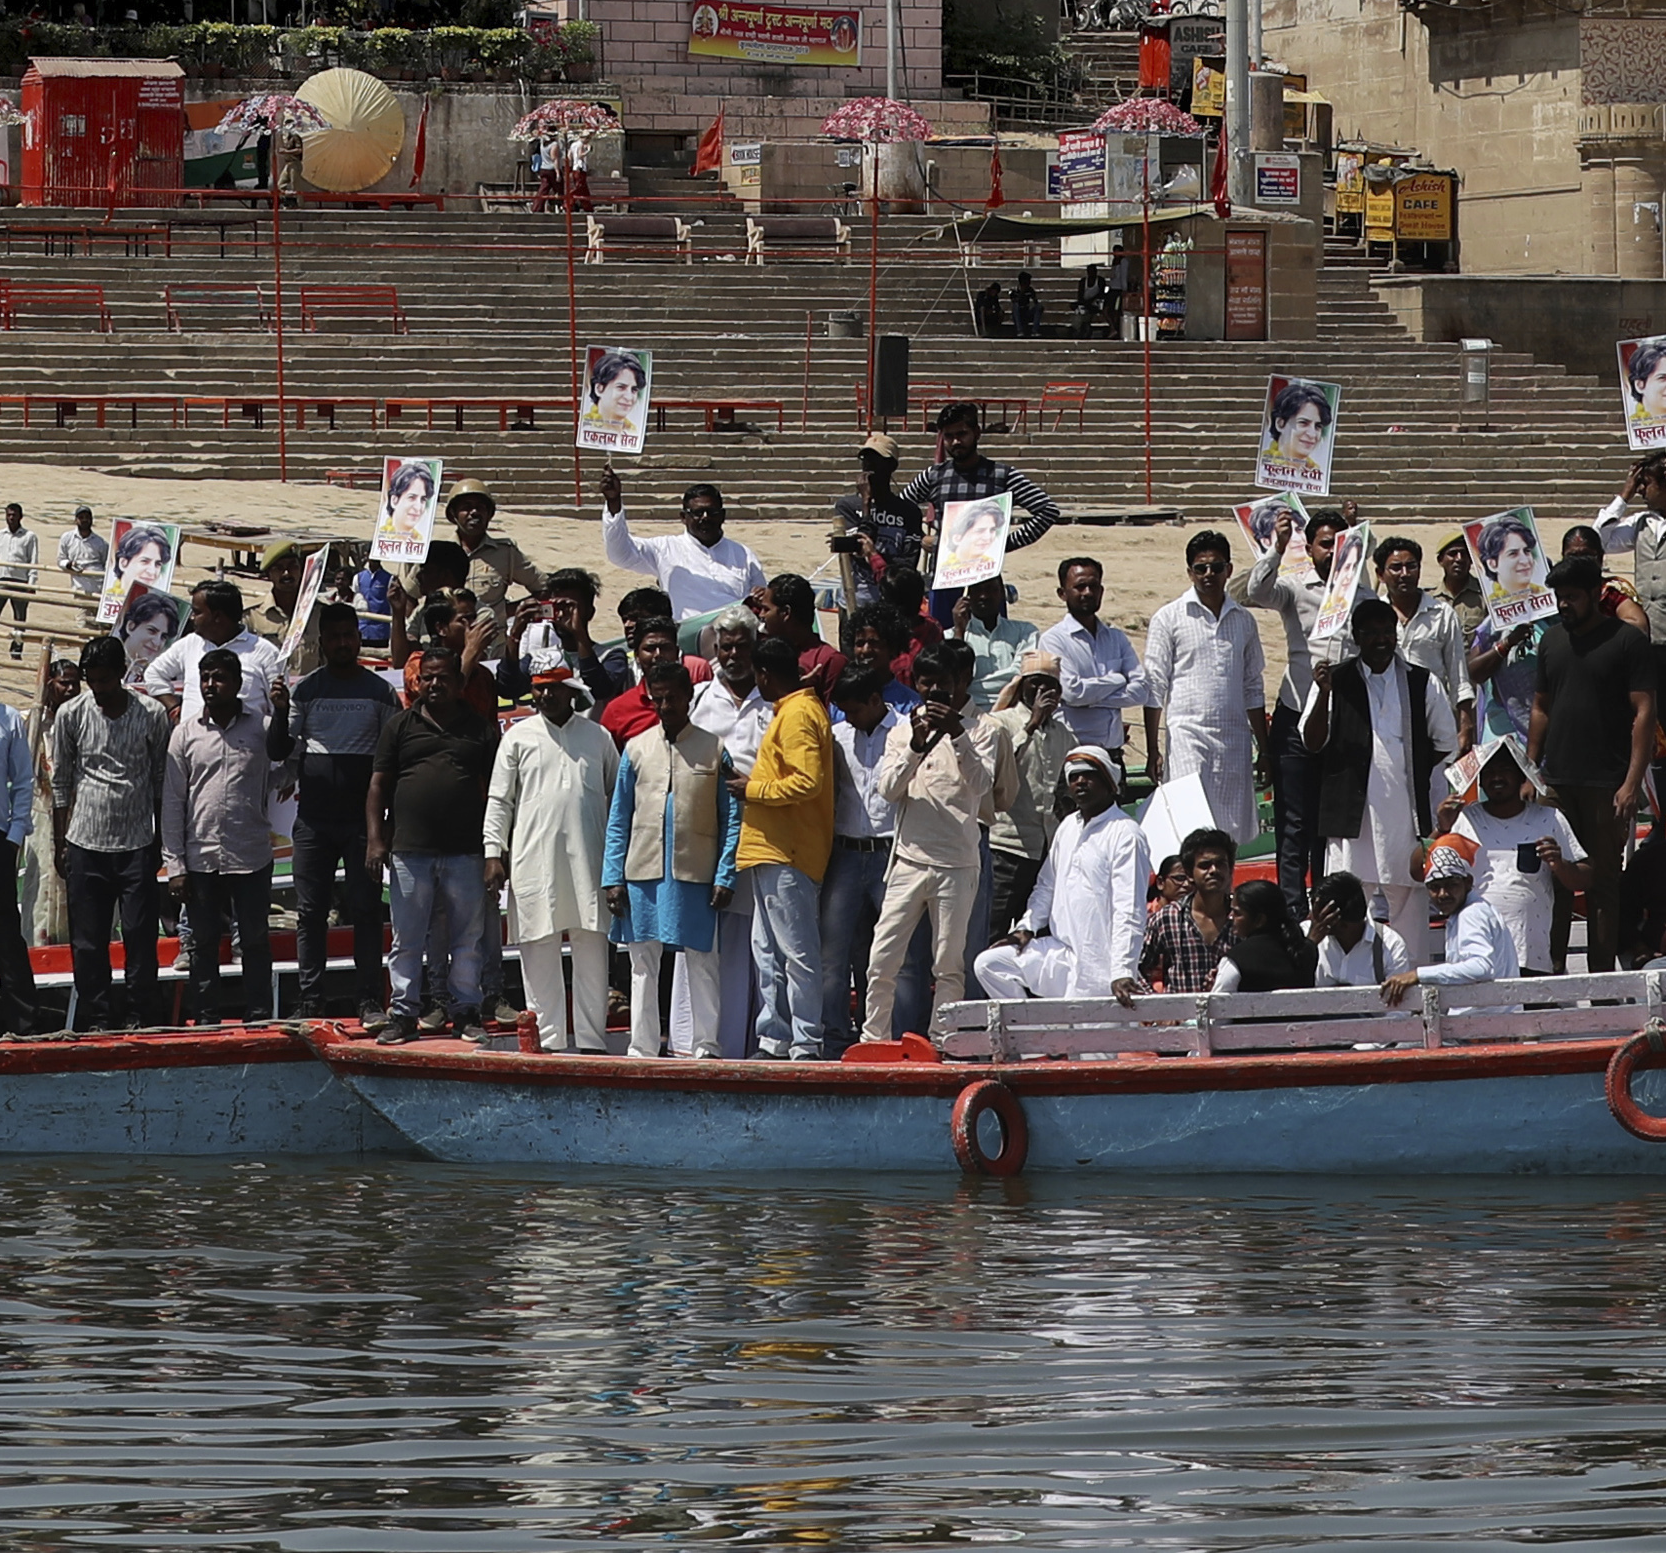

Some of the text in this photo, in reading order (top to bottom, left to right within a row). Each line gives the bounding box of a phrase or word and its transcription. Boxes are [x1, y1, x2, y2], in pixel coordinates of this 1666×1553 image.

[1398, 179, 1446, 195] Ashish
[1403, 199, 1438, 210] CAFE
[621, 431, 638, 447] सेना
[1634, 425, 1666, 445] फूलन
[1264, 463, 1323, 481] फूलन देवी
[378, 537, 425, 556] फूलन सेना
[1494, 593, 1554, 623] फूलन सेना
